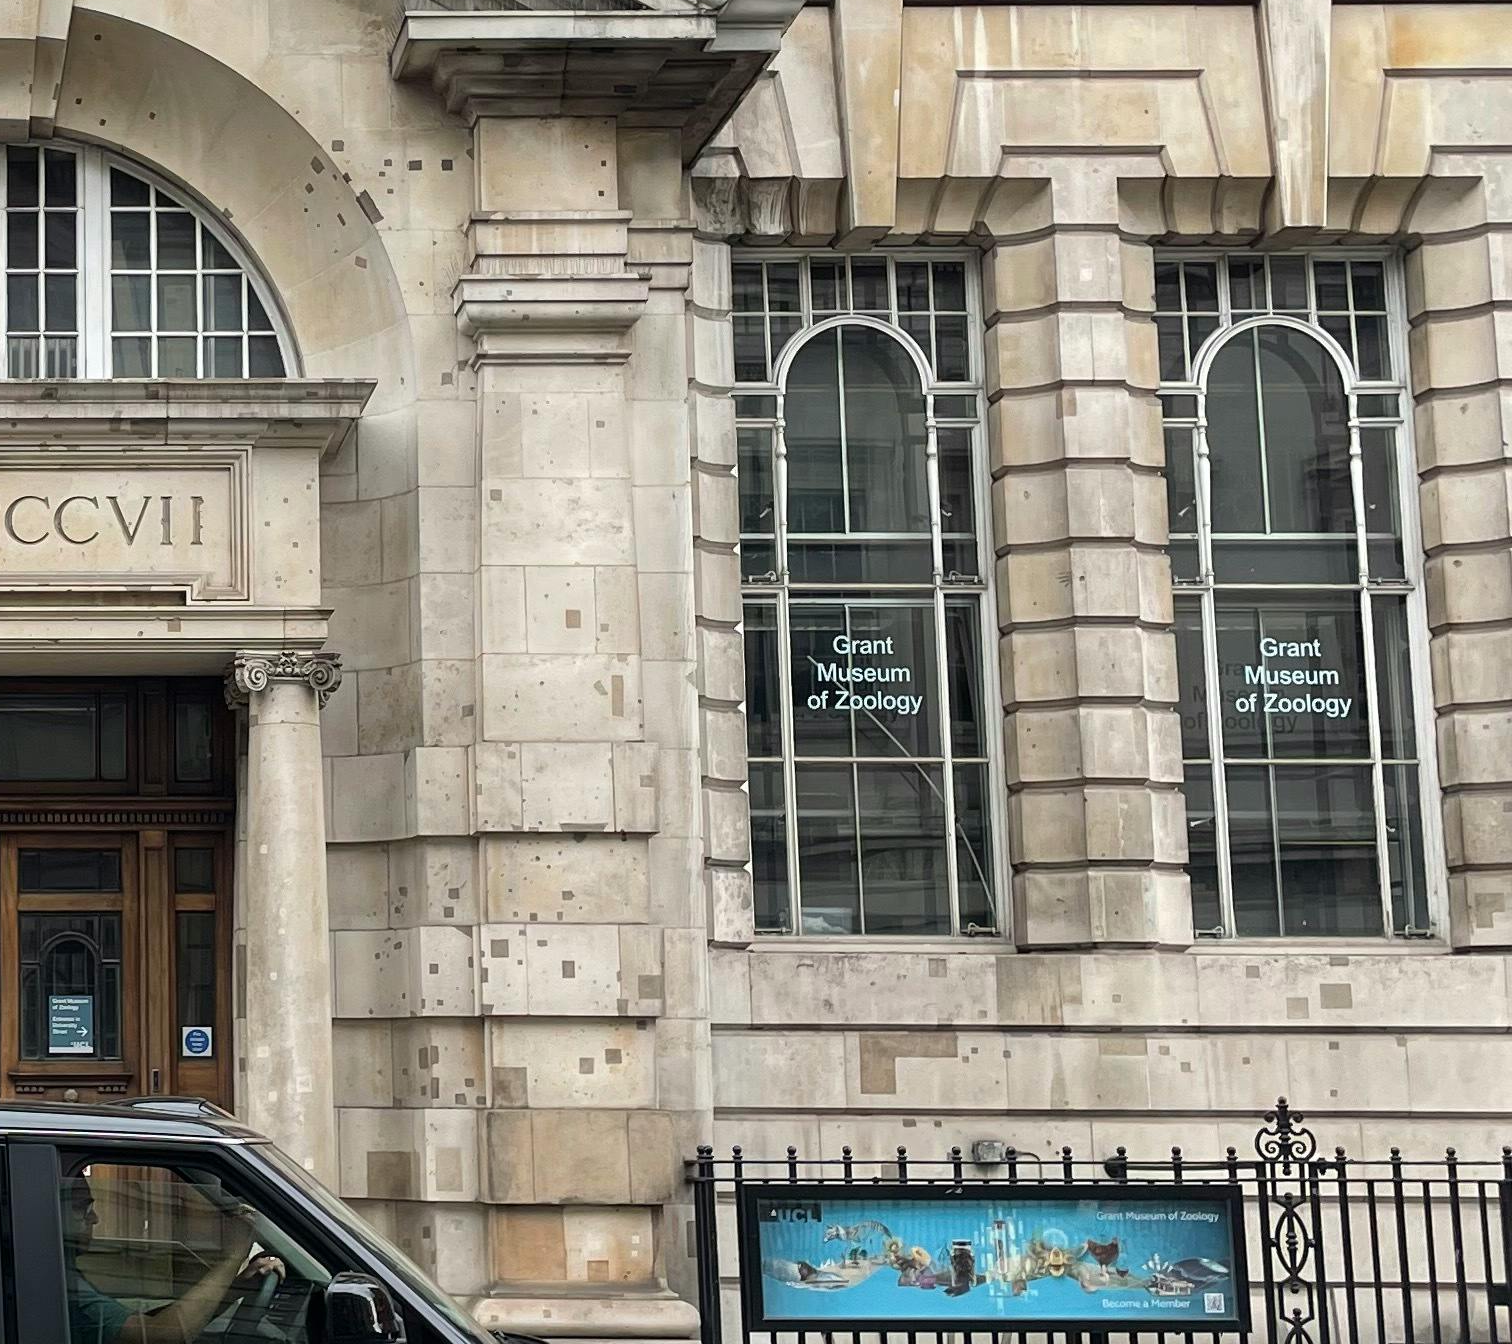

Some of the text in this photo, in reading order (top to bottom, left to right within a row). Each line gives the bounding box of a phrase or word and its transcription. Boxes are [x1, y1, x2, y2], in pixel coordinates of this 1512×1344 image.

[832, 635, 894, 655] Grant
[1259, 637, 1322, 657] Grant
[817, 662, 911, 682] Museum
[1245, 665, 1339, 685] Museum
[807, 690, 923, 714] of Zoology
[1235, 692, 1352, 718] of Zoology
[777, 1208, 819, 1223] UCL
[1096, 1211, 1219, 1223] Grant Museum of Zoology
[1102, 1298, 1191, 1309] Become a Member
